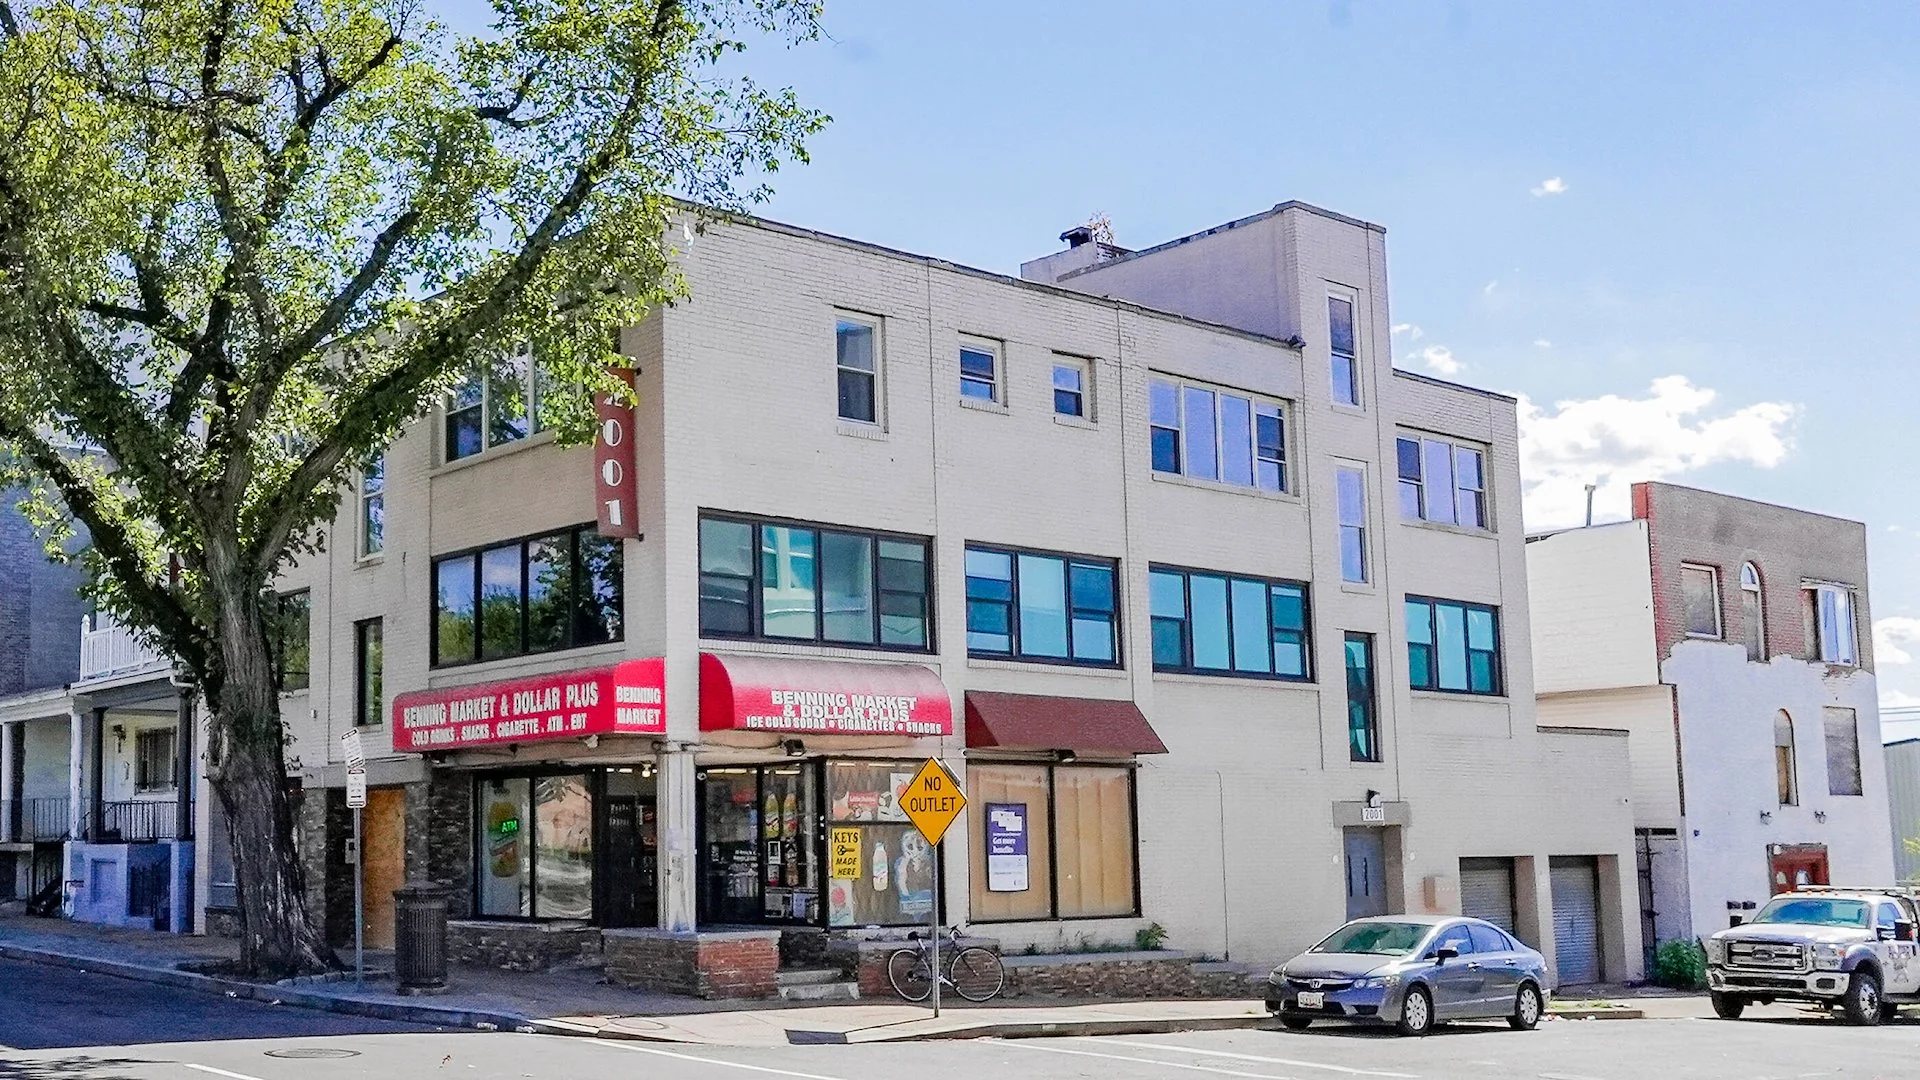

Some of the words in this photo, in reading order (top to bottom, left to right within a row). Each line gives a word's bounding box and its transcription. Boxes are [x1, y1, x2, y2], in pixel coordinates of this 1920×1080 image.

[616, 686, 661, 704] BENNING
[771, 690, 848, 707] BENNING
[851, 694, 917, 711] MARKET
[403, 703, 447, 729] BENNING
[450, 696, 496, 723] MARKET
[501, 694, 509, 717] &
[513, 687, 561, 716] DOLLAR
[566, 681, 599, 709] PLUS
[783, 704, 796, 718] &
[800, 705, 865, 721] DOLLAR
[868, 707, 910, 722] PLUS
[616, 708, 661, 726] MARKET
[746, 716, 763, 728] ICE
[765, 716, 792, 728] COLD
[793, 717, 826, 729] SODAS
[838, 718, 895, 732] CIGARETTES
[906, 721, 942, 734] SNACKS
[411, 731, 429, 746] COLD
[461, 723, 490, 741] SNACKS
[496, 718, 539, 738] CIGARETTE
[547, 714, 563, 733] ATM
[570, 712, 588, 730] EBT
[924, 776, 941, 791] NO
[910, 797, 956, 813] OUTLET
[1365, 809, 1383, 819] 2001
[501, 820, 518, 833] ATM
[833, 832, 859, 844] KEYS
[836, 858, 857, 866] MADE
[837, 868, 857, 876] HERE
